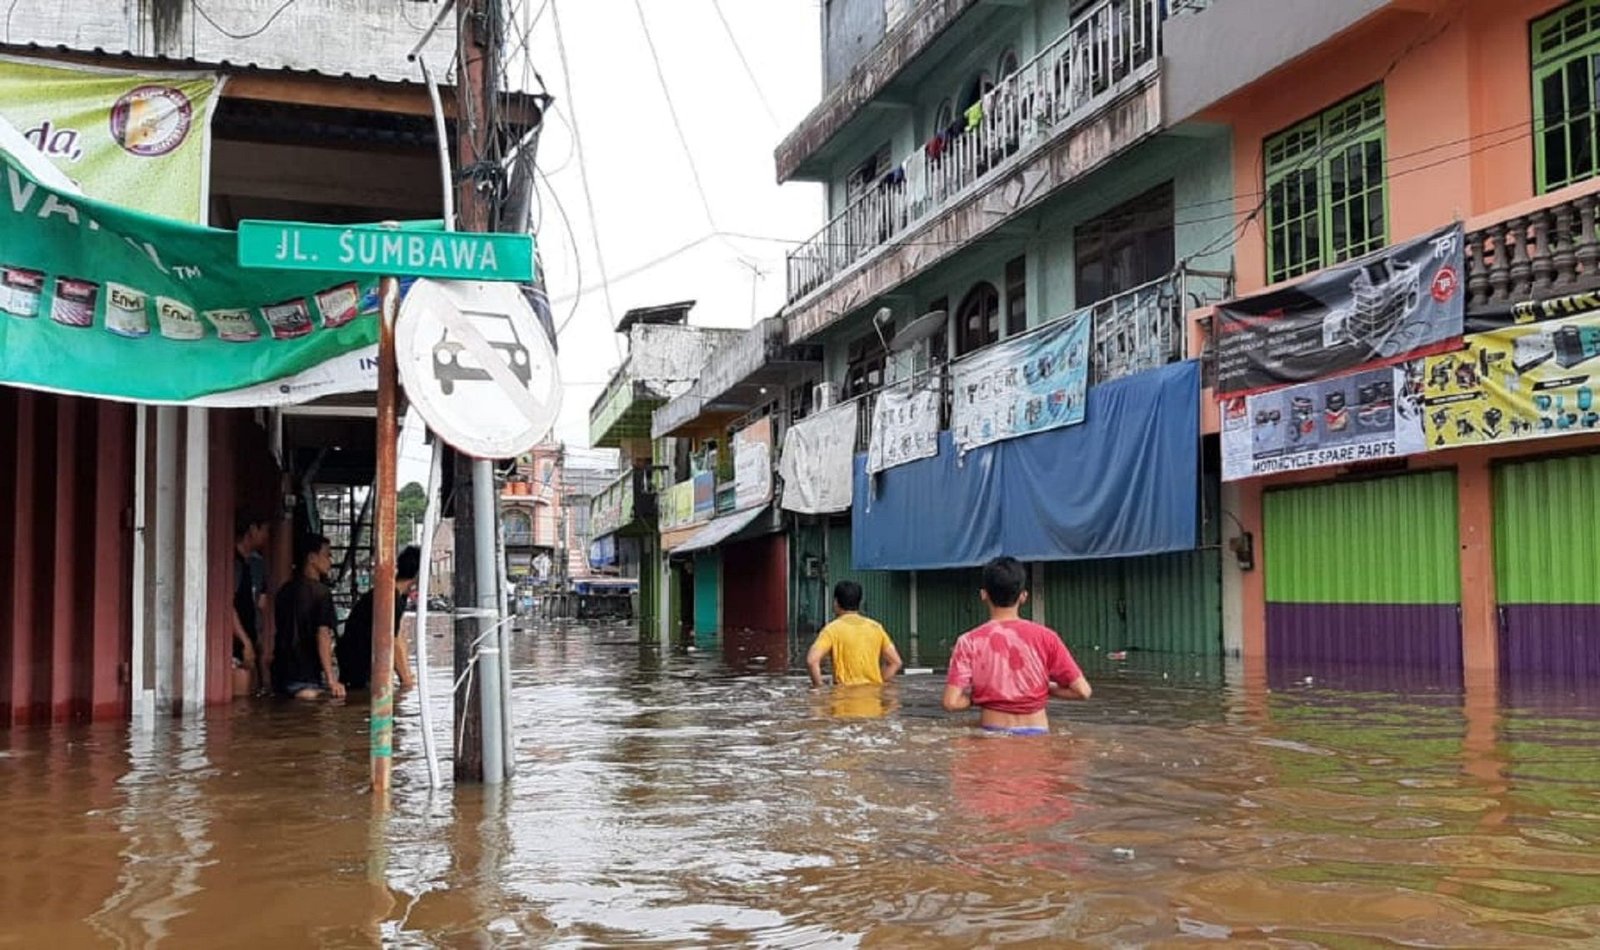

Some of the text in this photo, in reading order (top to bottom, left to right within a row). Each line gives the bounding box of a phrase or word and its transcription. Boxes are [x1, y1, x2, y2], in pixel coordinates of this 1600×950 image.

[275, 229, 498, 271] JL. SUMBAWA
[1318, 445, 1353, 465] SPARE
[1357, 441, 1396, 457] PARTS
